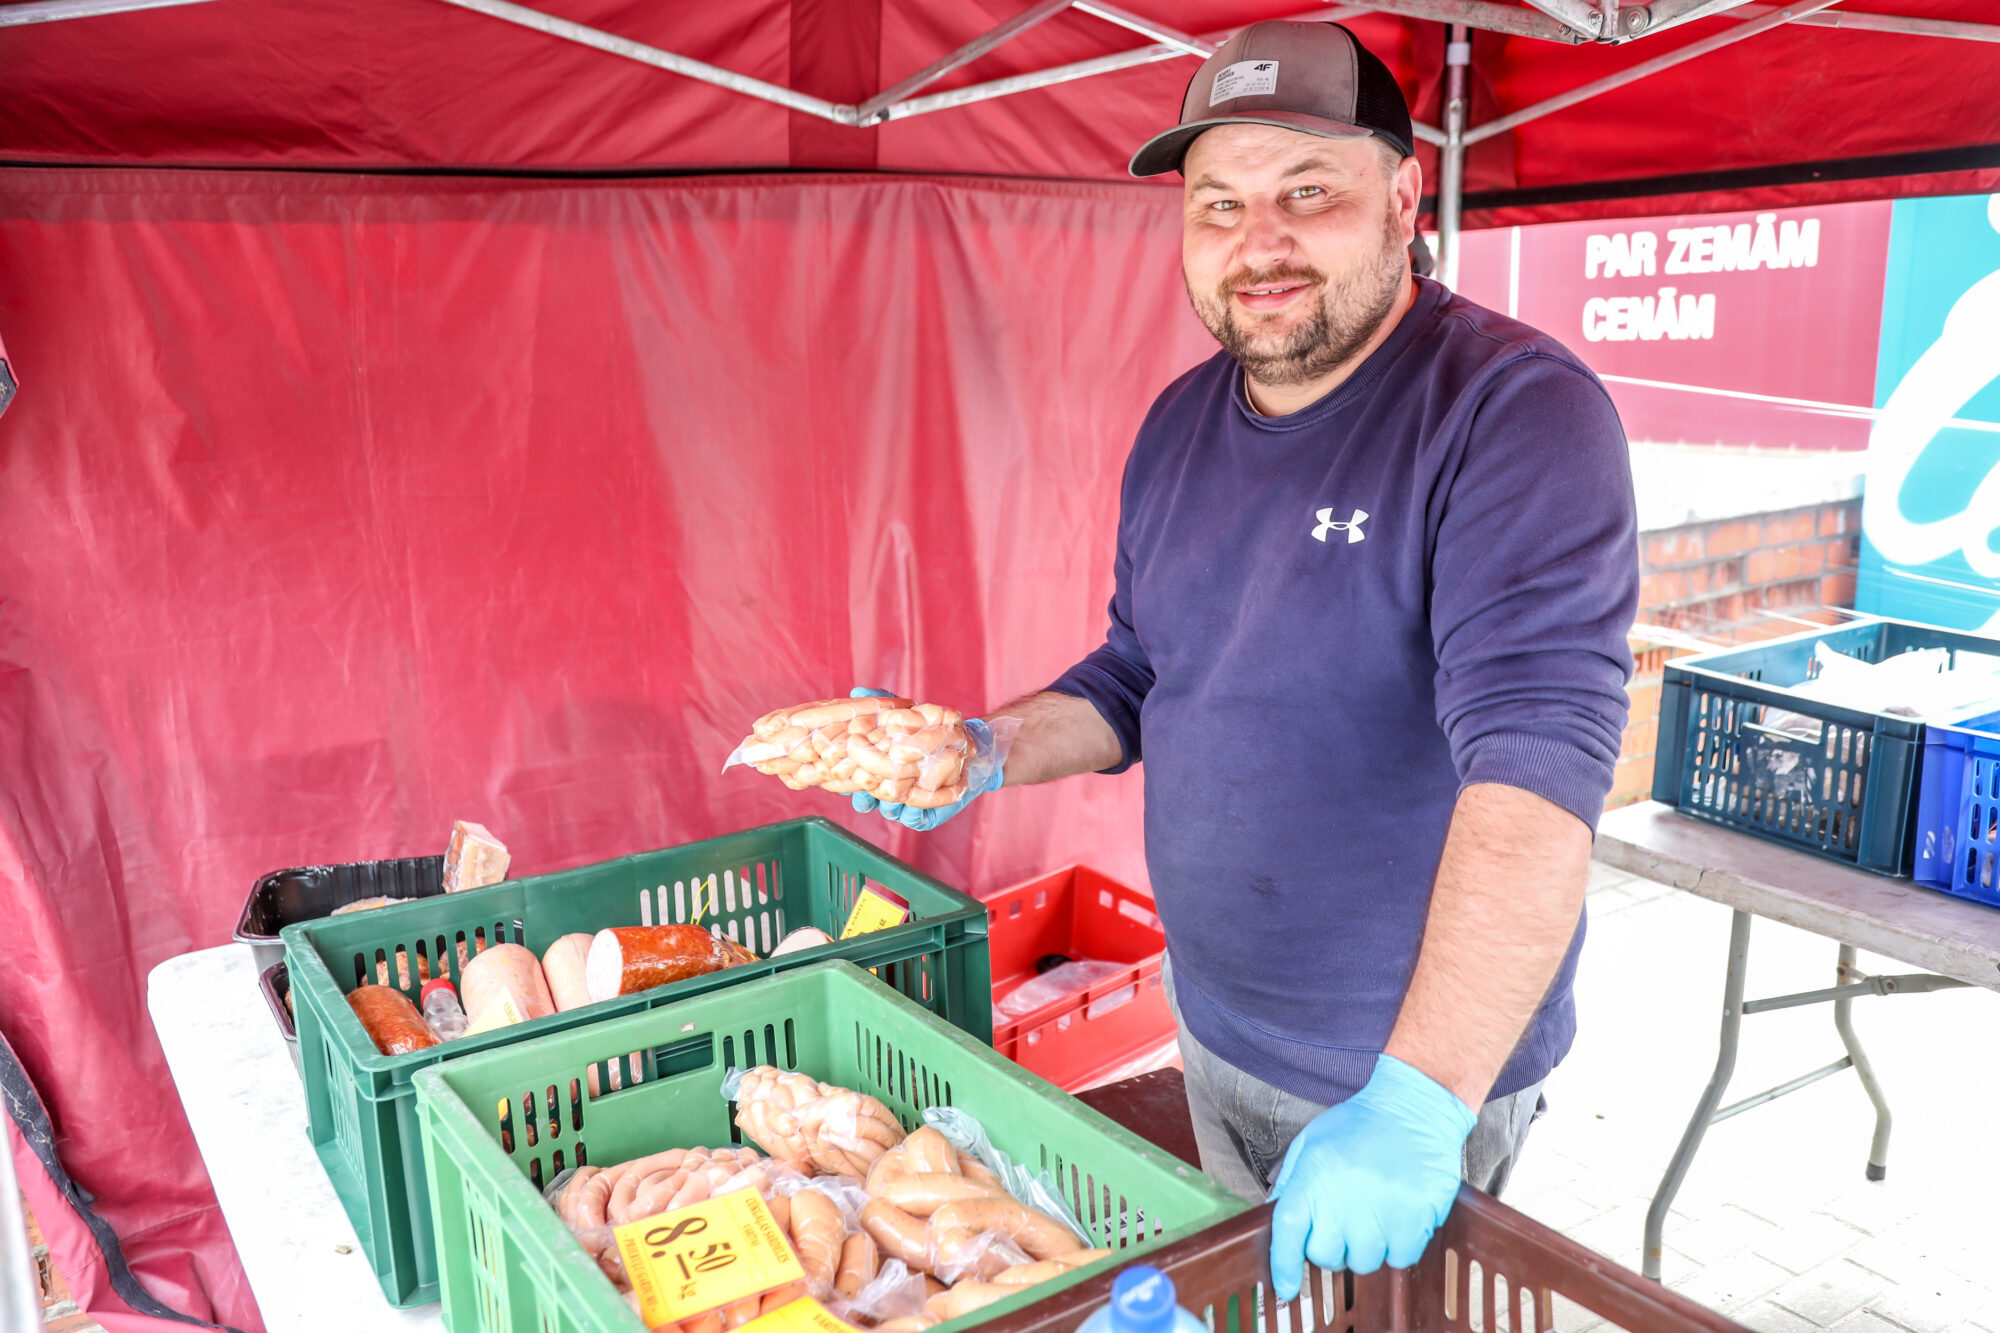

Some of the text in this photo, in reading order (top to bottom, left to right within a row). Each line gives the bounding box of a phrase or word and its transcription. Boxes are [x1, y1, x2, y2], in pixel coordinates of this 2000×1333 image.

[1254, 63, 1273, 72] 4F
[1585, 213, 1820, 279] PAR ZEMĀM
[1582, 287, 1716, 342] CENĀM
[679, 1281, 697, 1300] kg
